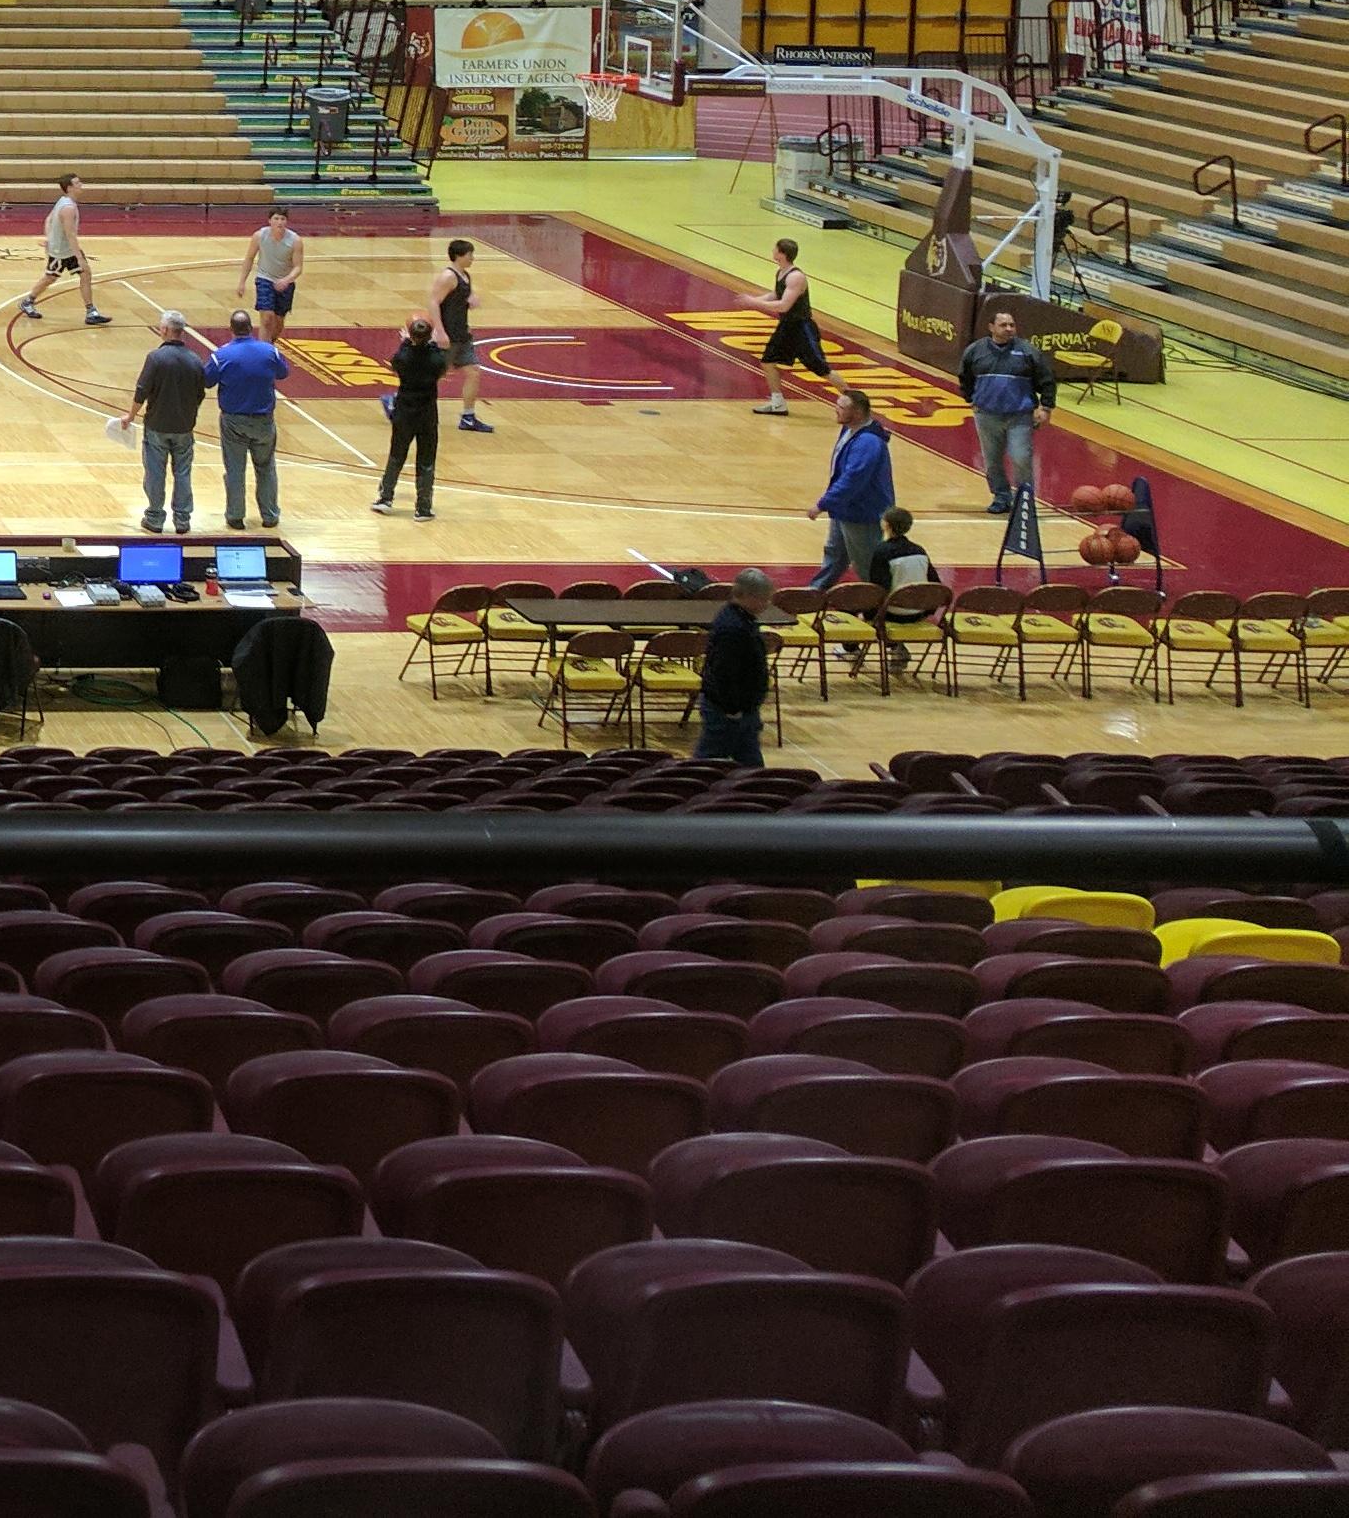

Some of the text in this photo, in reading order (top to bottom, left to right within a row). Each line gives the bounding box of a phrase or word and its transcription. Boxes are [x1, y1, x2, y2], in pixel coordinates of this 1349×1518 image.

[462, 58, 567, 70] FARMERS UNION
[449, 73, 523, 84] INSURANCE
[1020, 490, 1030, 550] EAGLES
